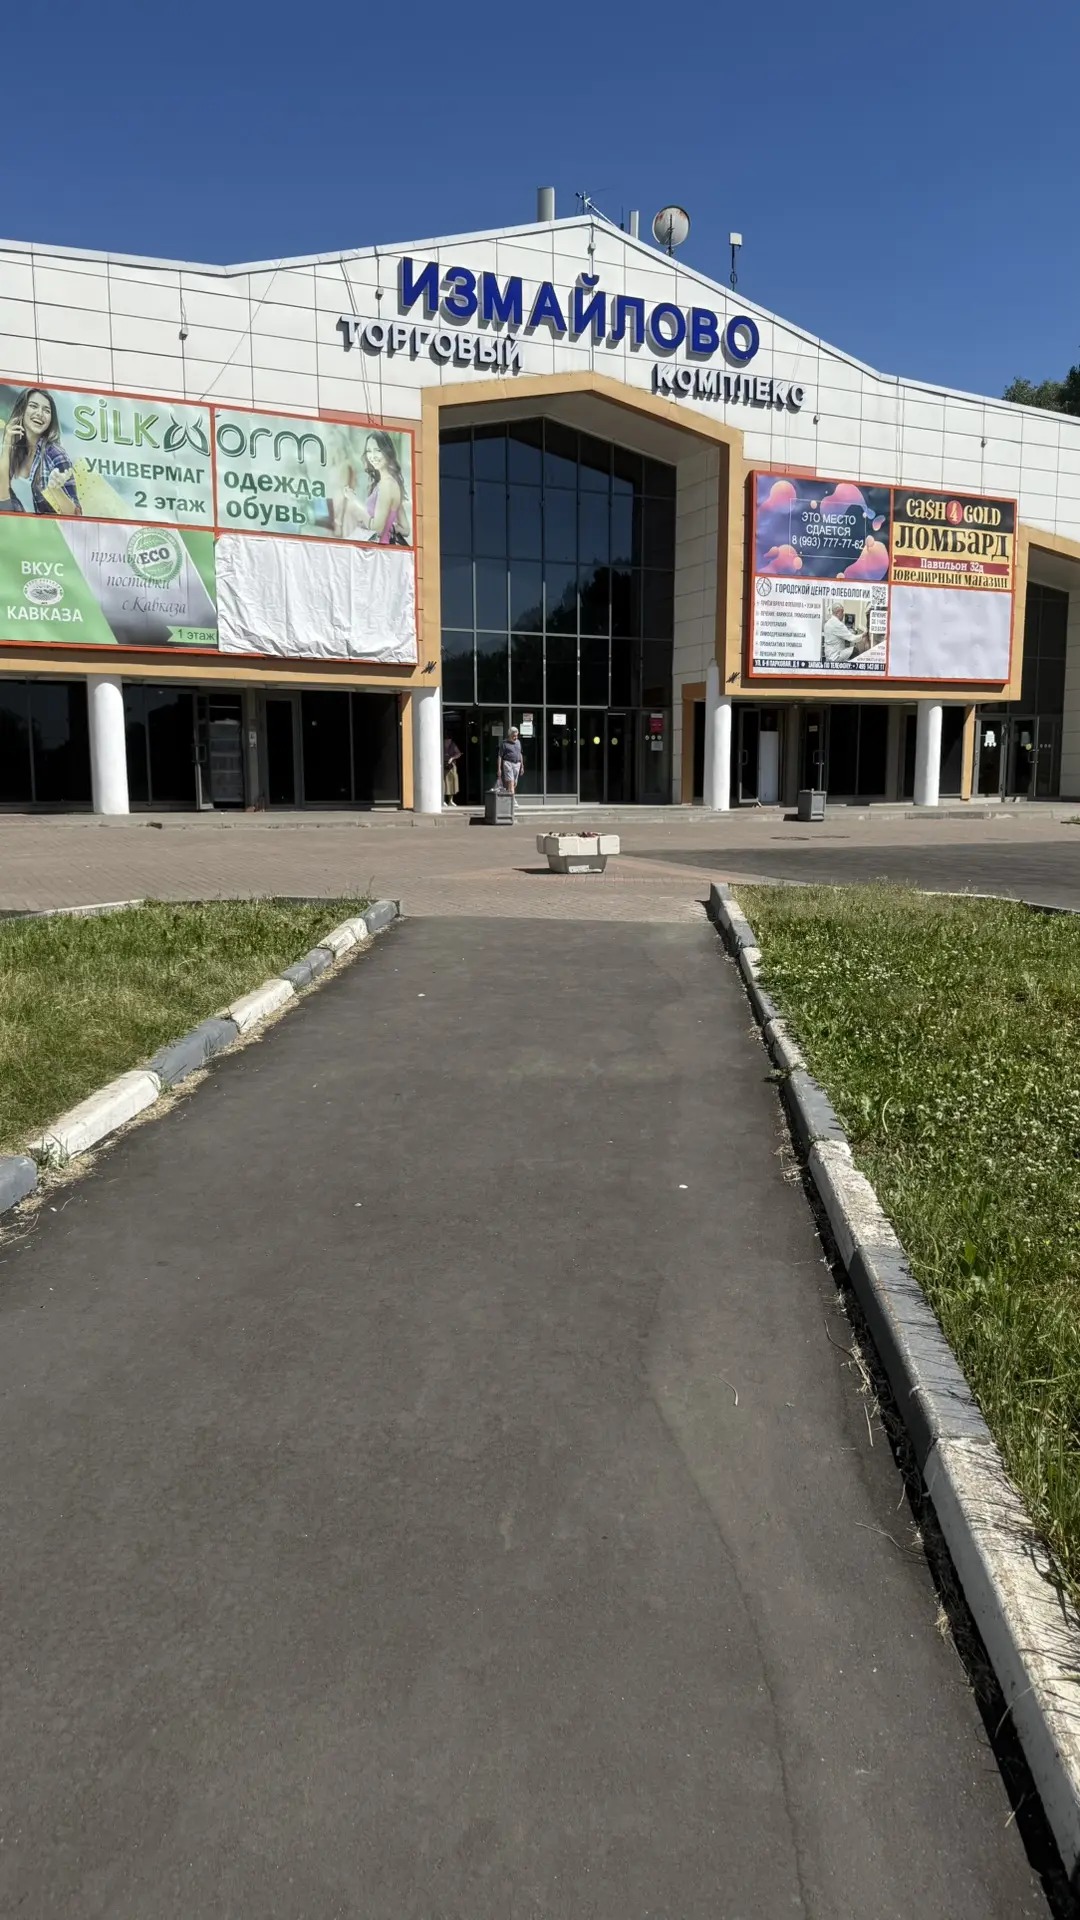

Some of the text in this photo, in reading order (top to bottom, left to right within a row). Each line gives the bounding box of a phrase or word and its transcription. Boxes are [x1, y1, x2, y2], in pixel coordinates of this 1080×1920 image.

[400, 256, 761, 361] ИЗМАЙЛОВО
[337, 313, 524, 370] ТОРГОВЫЙ
[655, 362, 807, 409] КОМПЛЕКС
[85, 457, 205, 484] УНИВЕРМАГ
[223, 471, 326, 500] одежда
[134, 492, 206, 514] 2 этаж
[226, 495, 306, 526] обувь
[801, 511, 856, 525] ЭТО МЕСТО
[963, 504, 1001, 526] GOLD
[806, 524, 851, 536] СДАЕТСЯ
[791, 535, 864, 549] 8 (993) 777-77-62
[139, 547, 170, 565] ECO
[920, 558, 967, 572] Павильон
[21, 560, 64, 577] ВКУС
[106, 575, 171, 590] поставки
[775, 583, 871, 599] ГОРОДСКОЙ ЦЕНТР ФЛЕБОЛОГИИ
[7, 605, 83, 622] КАВКАЗА
[130, 596, 186, 618] Кавказа
[178, 629, 216, 641] 1 этаж
